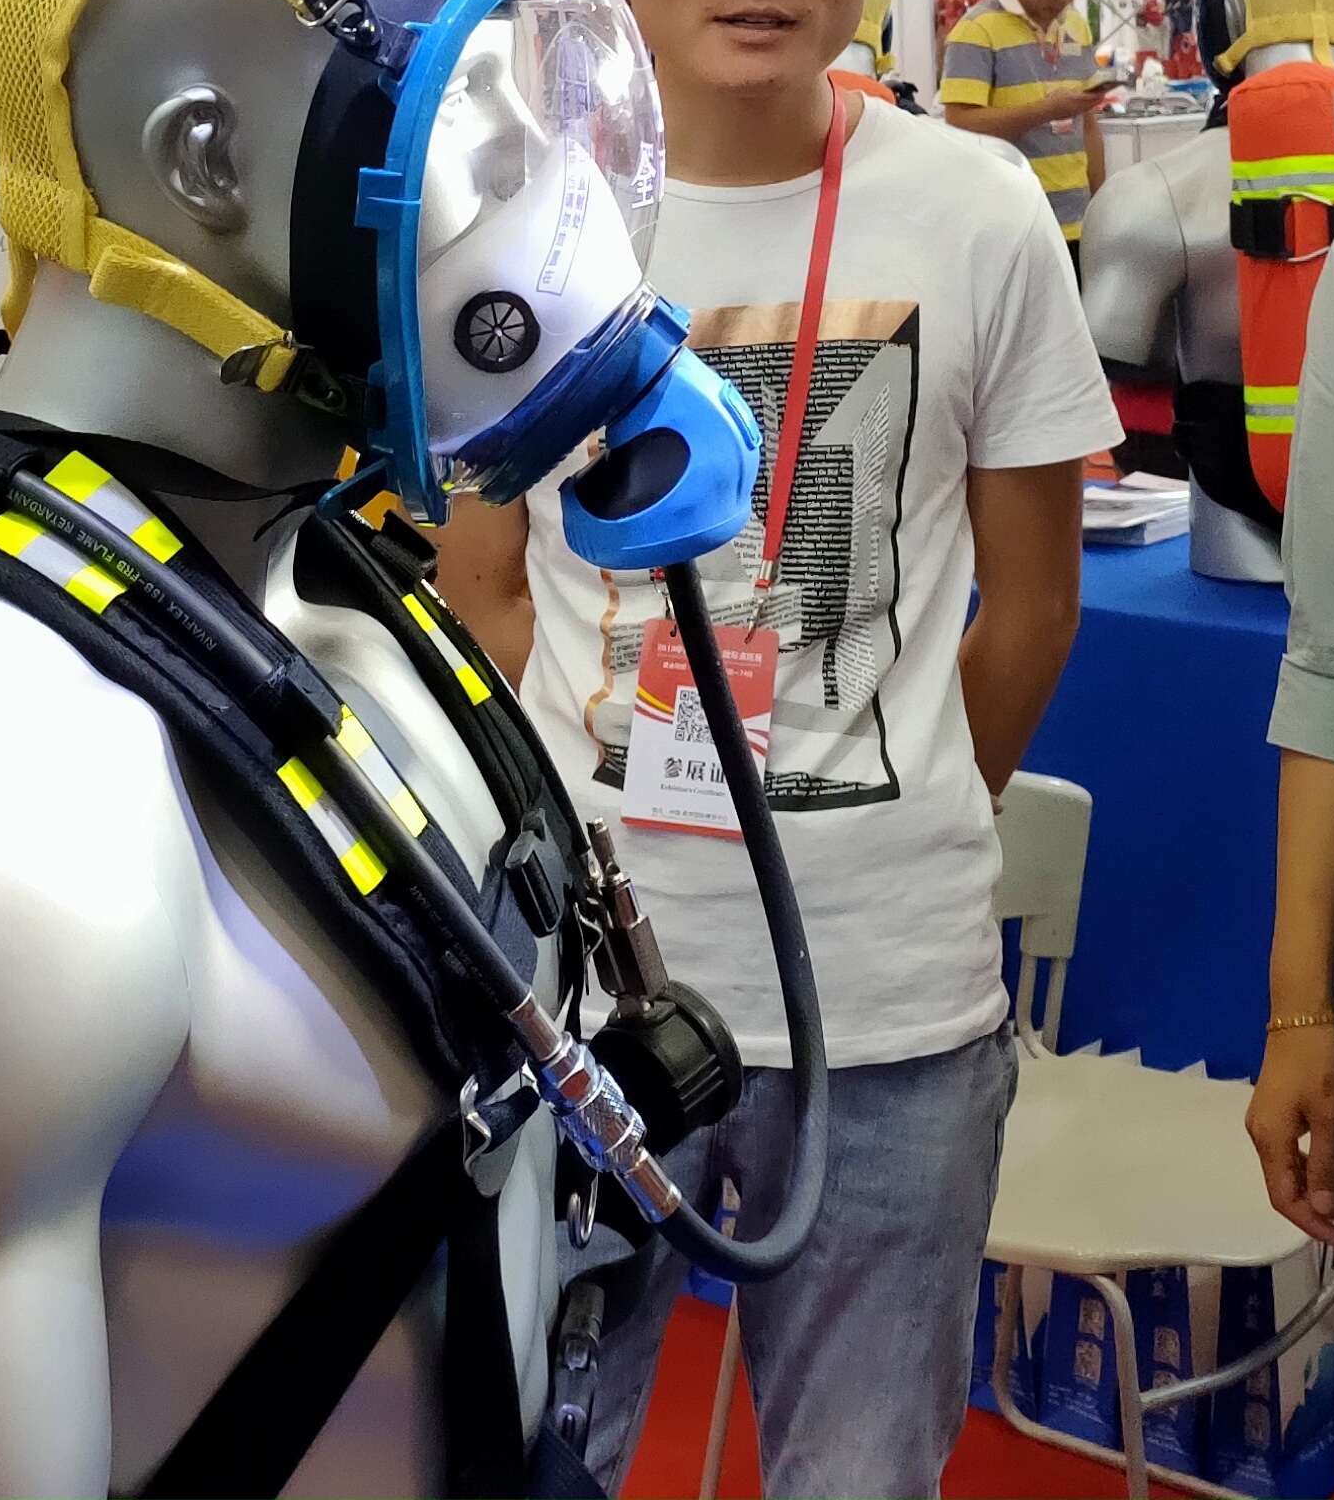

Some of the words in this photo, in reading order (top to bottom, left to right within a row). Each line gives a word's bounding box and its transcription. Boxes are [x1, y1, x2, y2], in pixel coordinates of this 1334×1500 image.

[4, 485, 75, 535] RETARDANT
[76, 529, 115, 563] FLAME
[167, 601, 219, 652] RIVAFLEX
